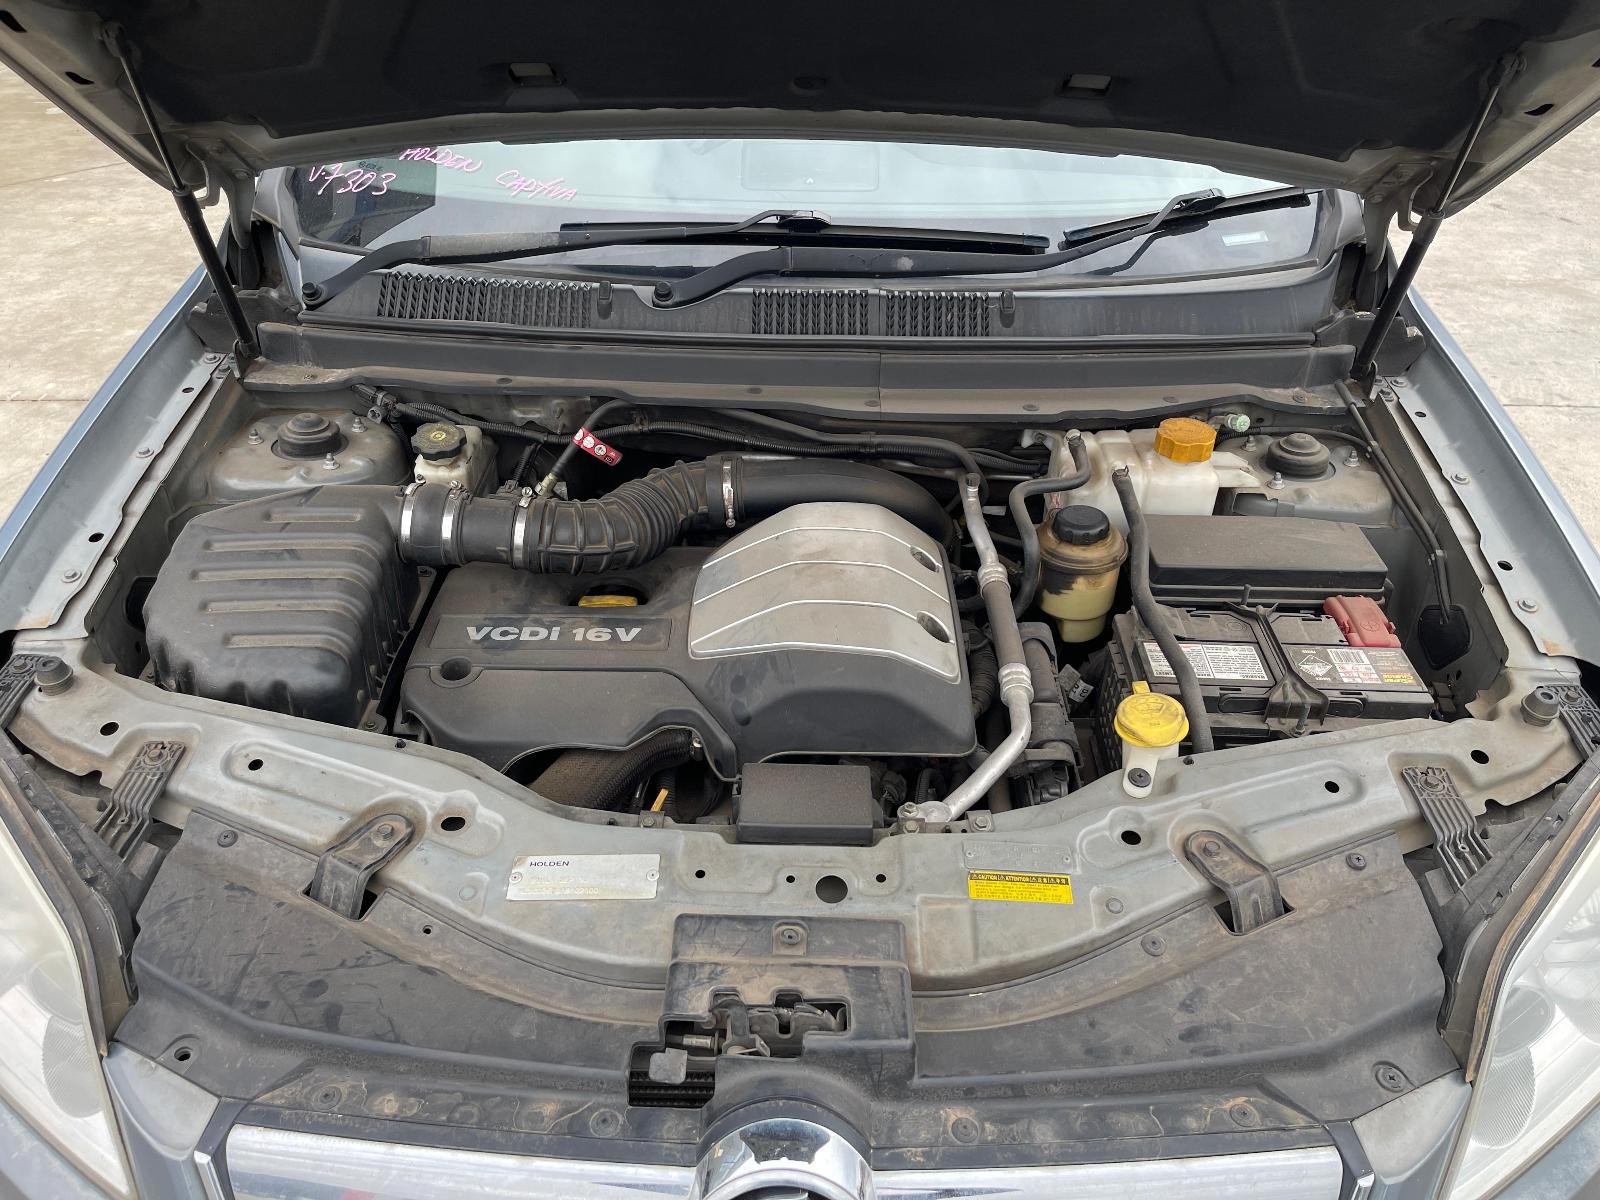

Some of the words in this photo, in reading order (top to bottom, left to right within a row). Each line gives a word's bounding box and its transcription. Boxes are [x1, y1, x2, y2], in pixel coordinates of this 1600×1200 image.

[399, 147, 482, 172] HOLDEN
[978, 873, 998, 881] CAUTION
[1005, 874, 1030, 882] ATTENTION
